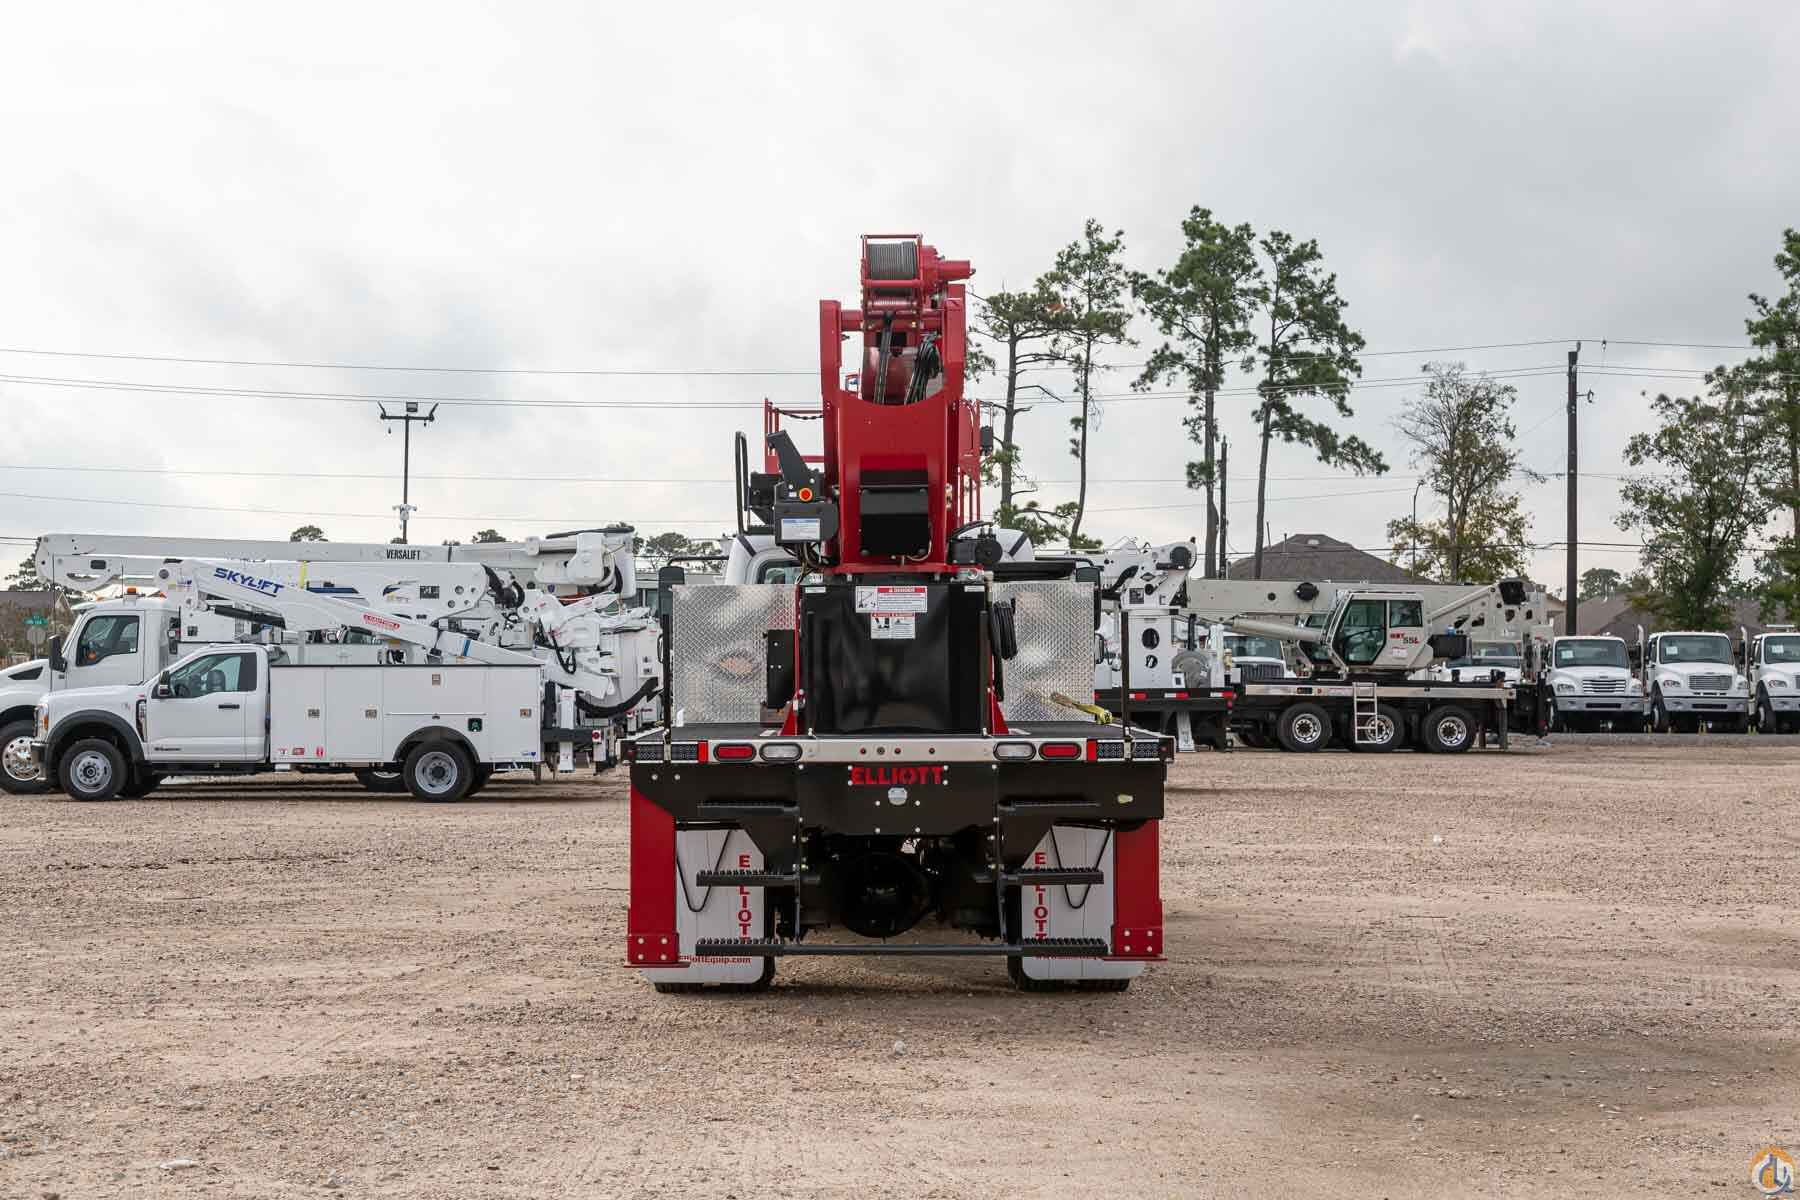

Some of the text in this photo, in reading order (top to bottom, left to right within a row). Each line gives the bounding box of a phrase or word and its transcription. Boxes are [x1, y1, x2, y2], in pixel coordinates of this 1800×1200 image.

[386, 549, 421, 560] VERSALIFT
[214, 567, 284, 594] SKYLIFT
[850, 767, 943, 785] ELLIOTT
[737, 855, 752, 942] ELIOT
